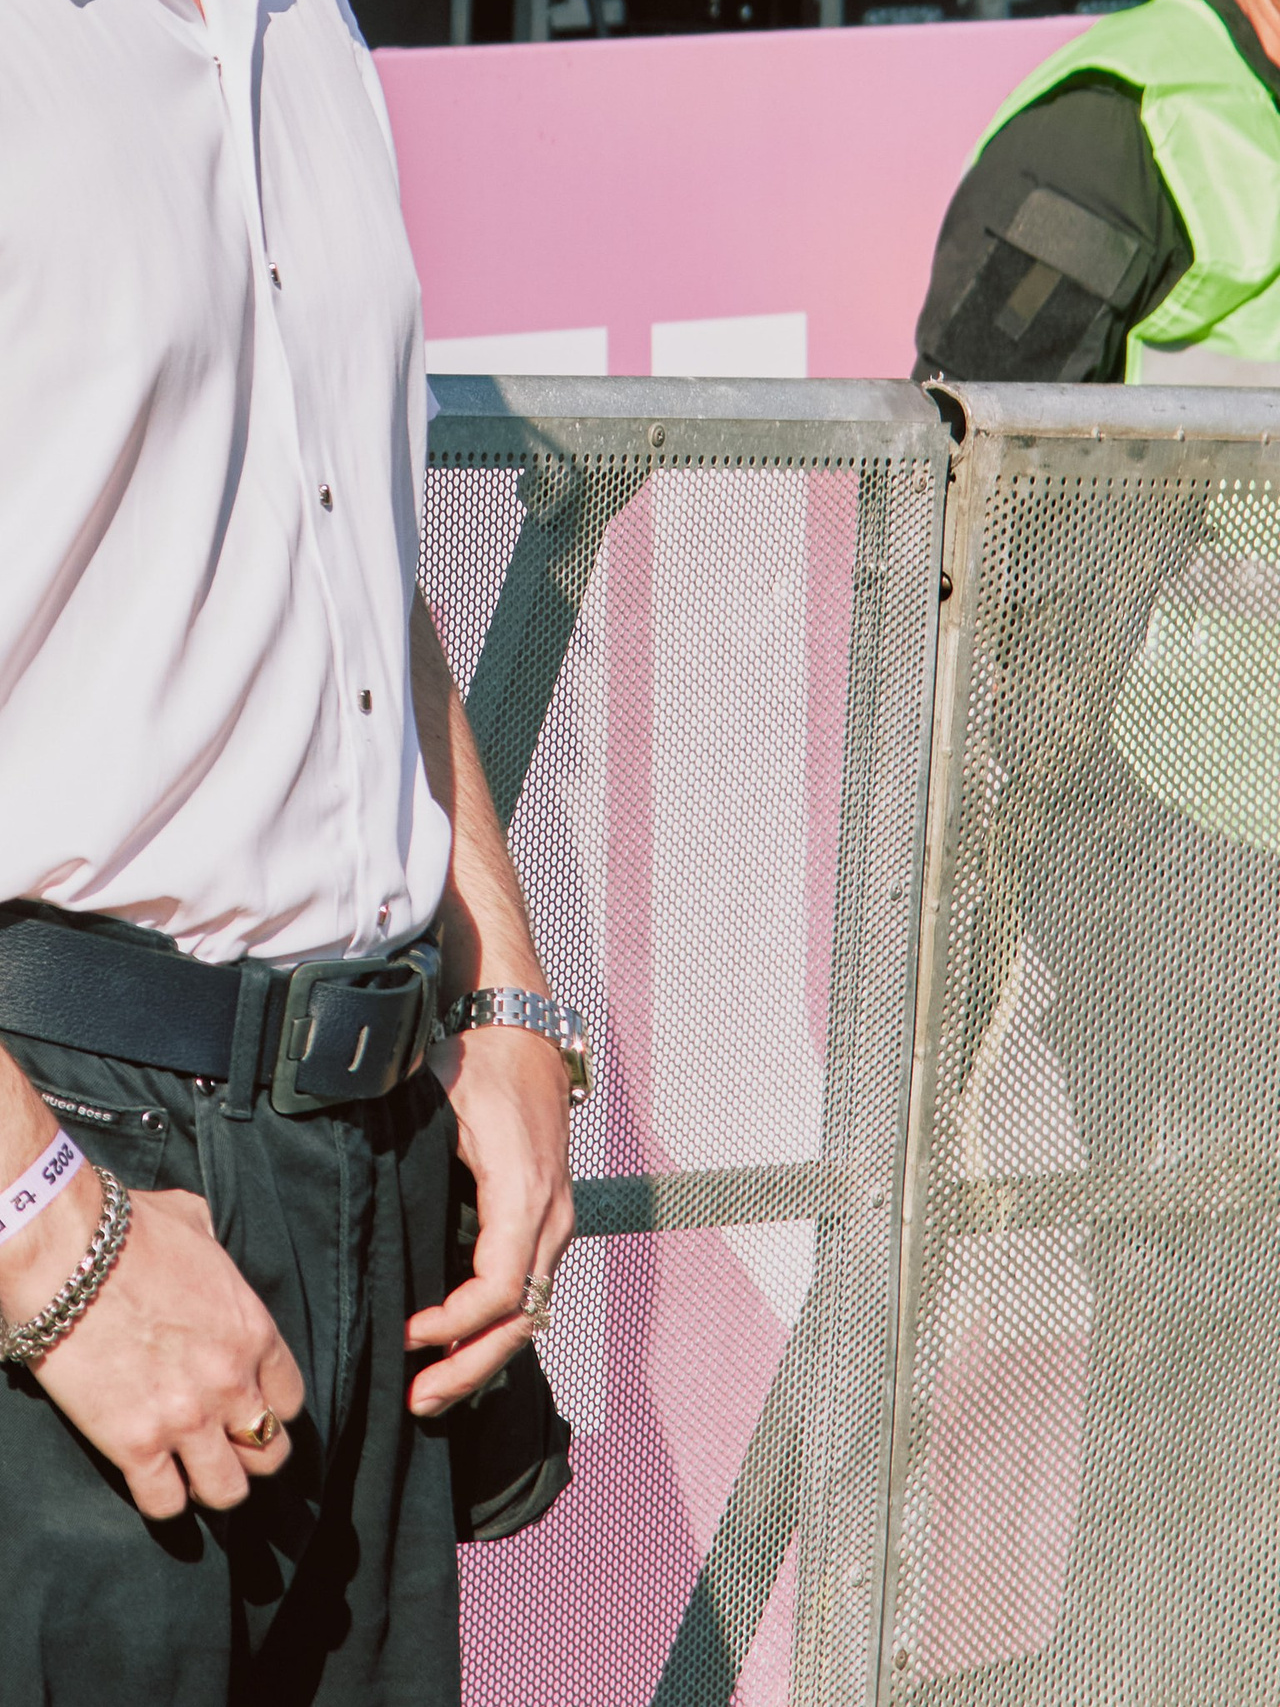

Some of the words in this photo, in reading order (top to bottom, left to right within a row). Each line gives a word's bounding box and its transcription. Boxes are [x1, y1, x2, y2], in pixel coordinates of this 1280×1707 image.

[41, 1092, 76, 1112] HUGO
[77, 1105, 113, 1123] BOSS
[41, 1141, 76, 1186] 2025
